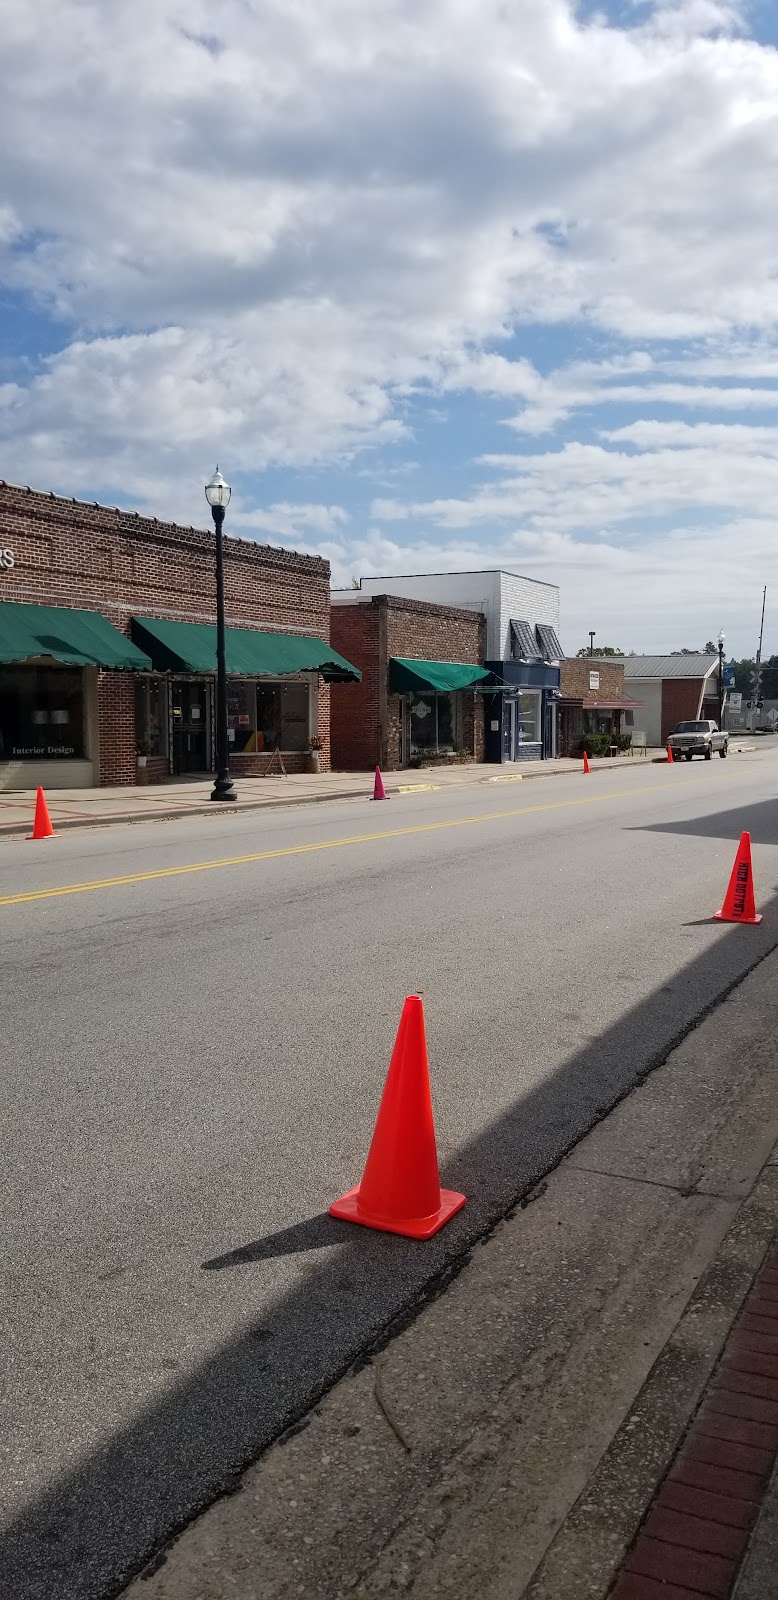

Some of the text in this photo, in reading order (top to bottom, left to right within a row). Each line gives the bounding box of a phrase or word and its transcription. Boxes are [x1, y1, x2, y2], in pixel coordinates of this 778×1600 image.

[12, 745, 75, 754] Interior Design
[737, 862, 748, 882] HIGH
[733, 883, 746, 913] OUTPUT
